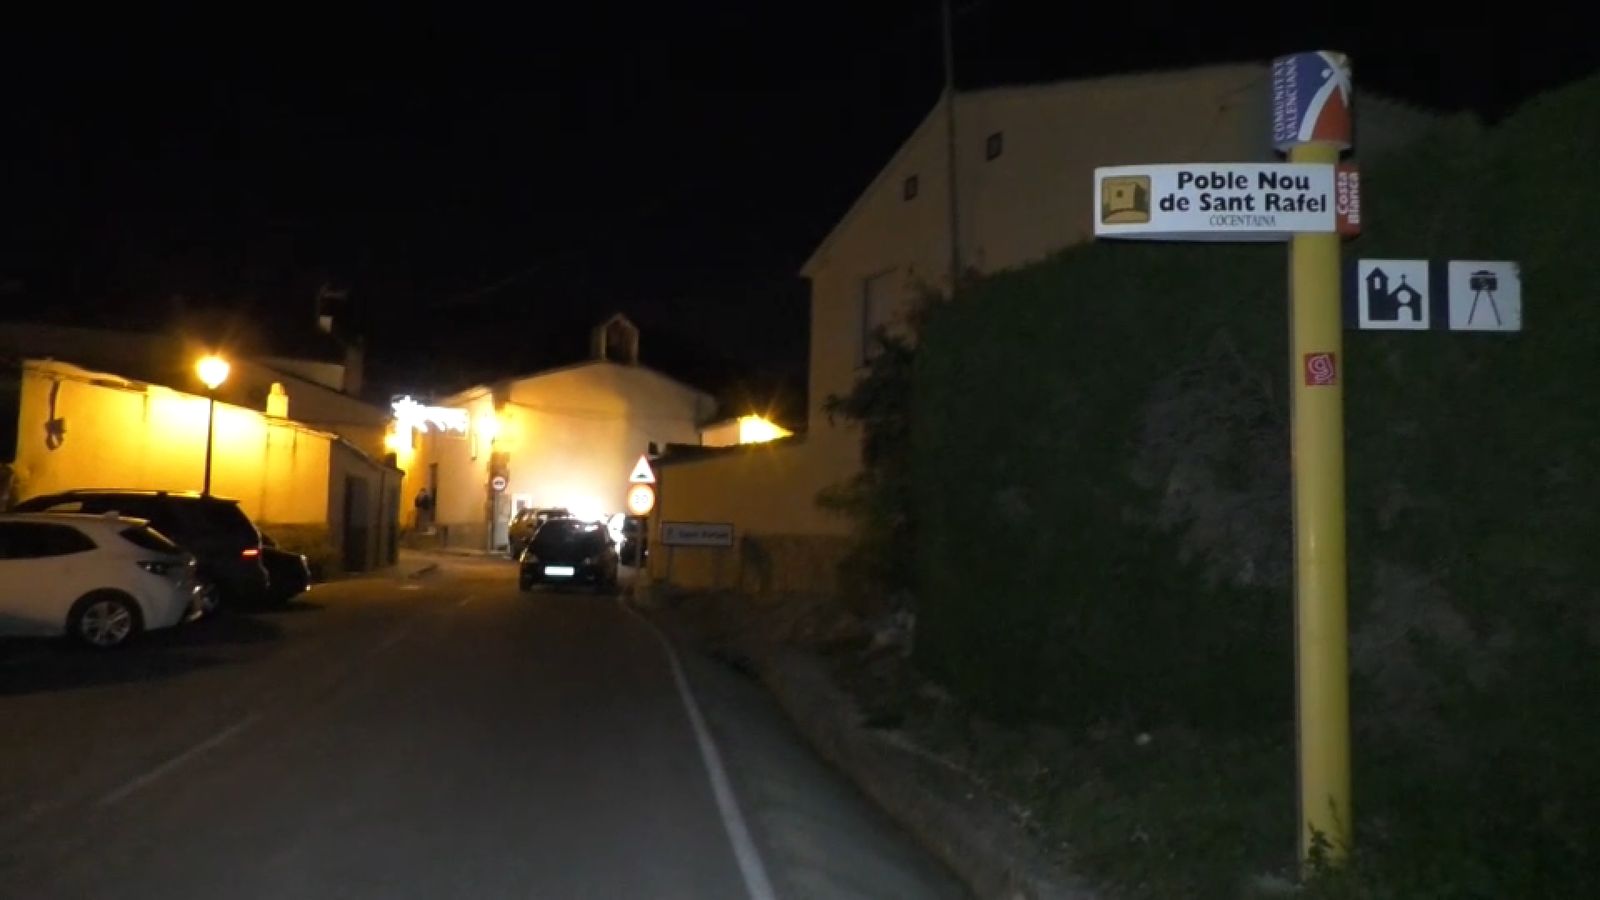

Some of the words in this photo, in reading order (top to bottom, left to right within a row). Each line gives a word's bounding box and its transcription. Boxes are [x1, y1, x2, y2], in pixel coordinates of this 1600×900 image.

[1285, 56, 1298, 140] VALENCIANA
[1177, 171, 1248, 190] Poble
[1257, 172, 1310, 190] Nou
[1337, 172, 1349, 215] Costa
[1159, 193, 1190, 212] de
[1198, 193, 1255, 212] Sant
[1264, 193, 1327, 212] Rafel
[1348, 172, 1360, 224] Blanca
[1209, 214, 1277, 226] COCENTAINA
